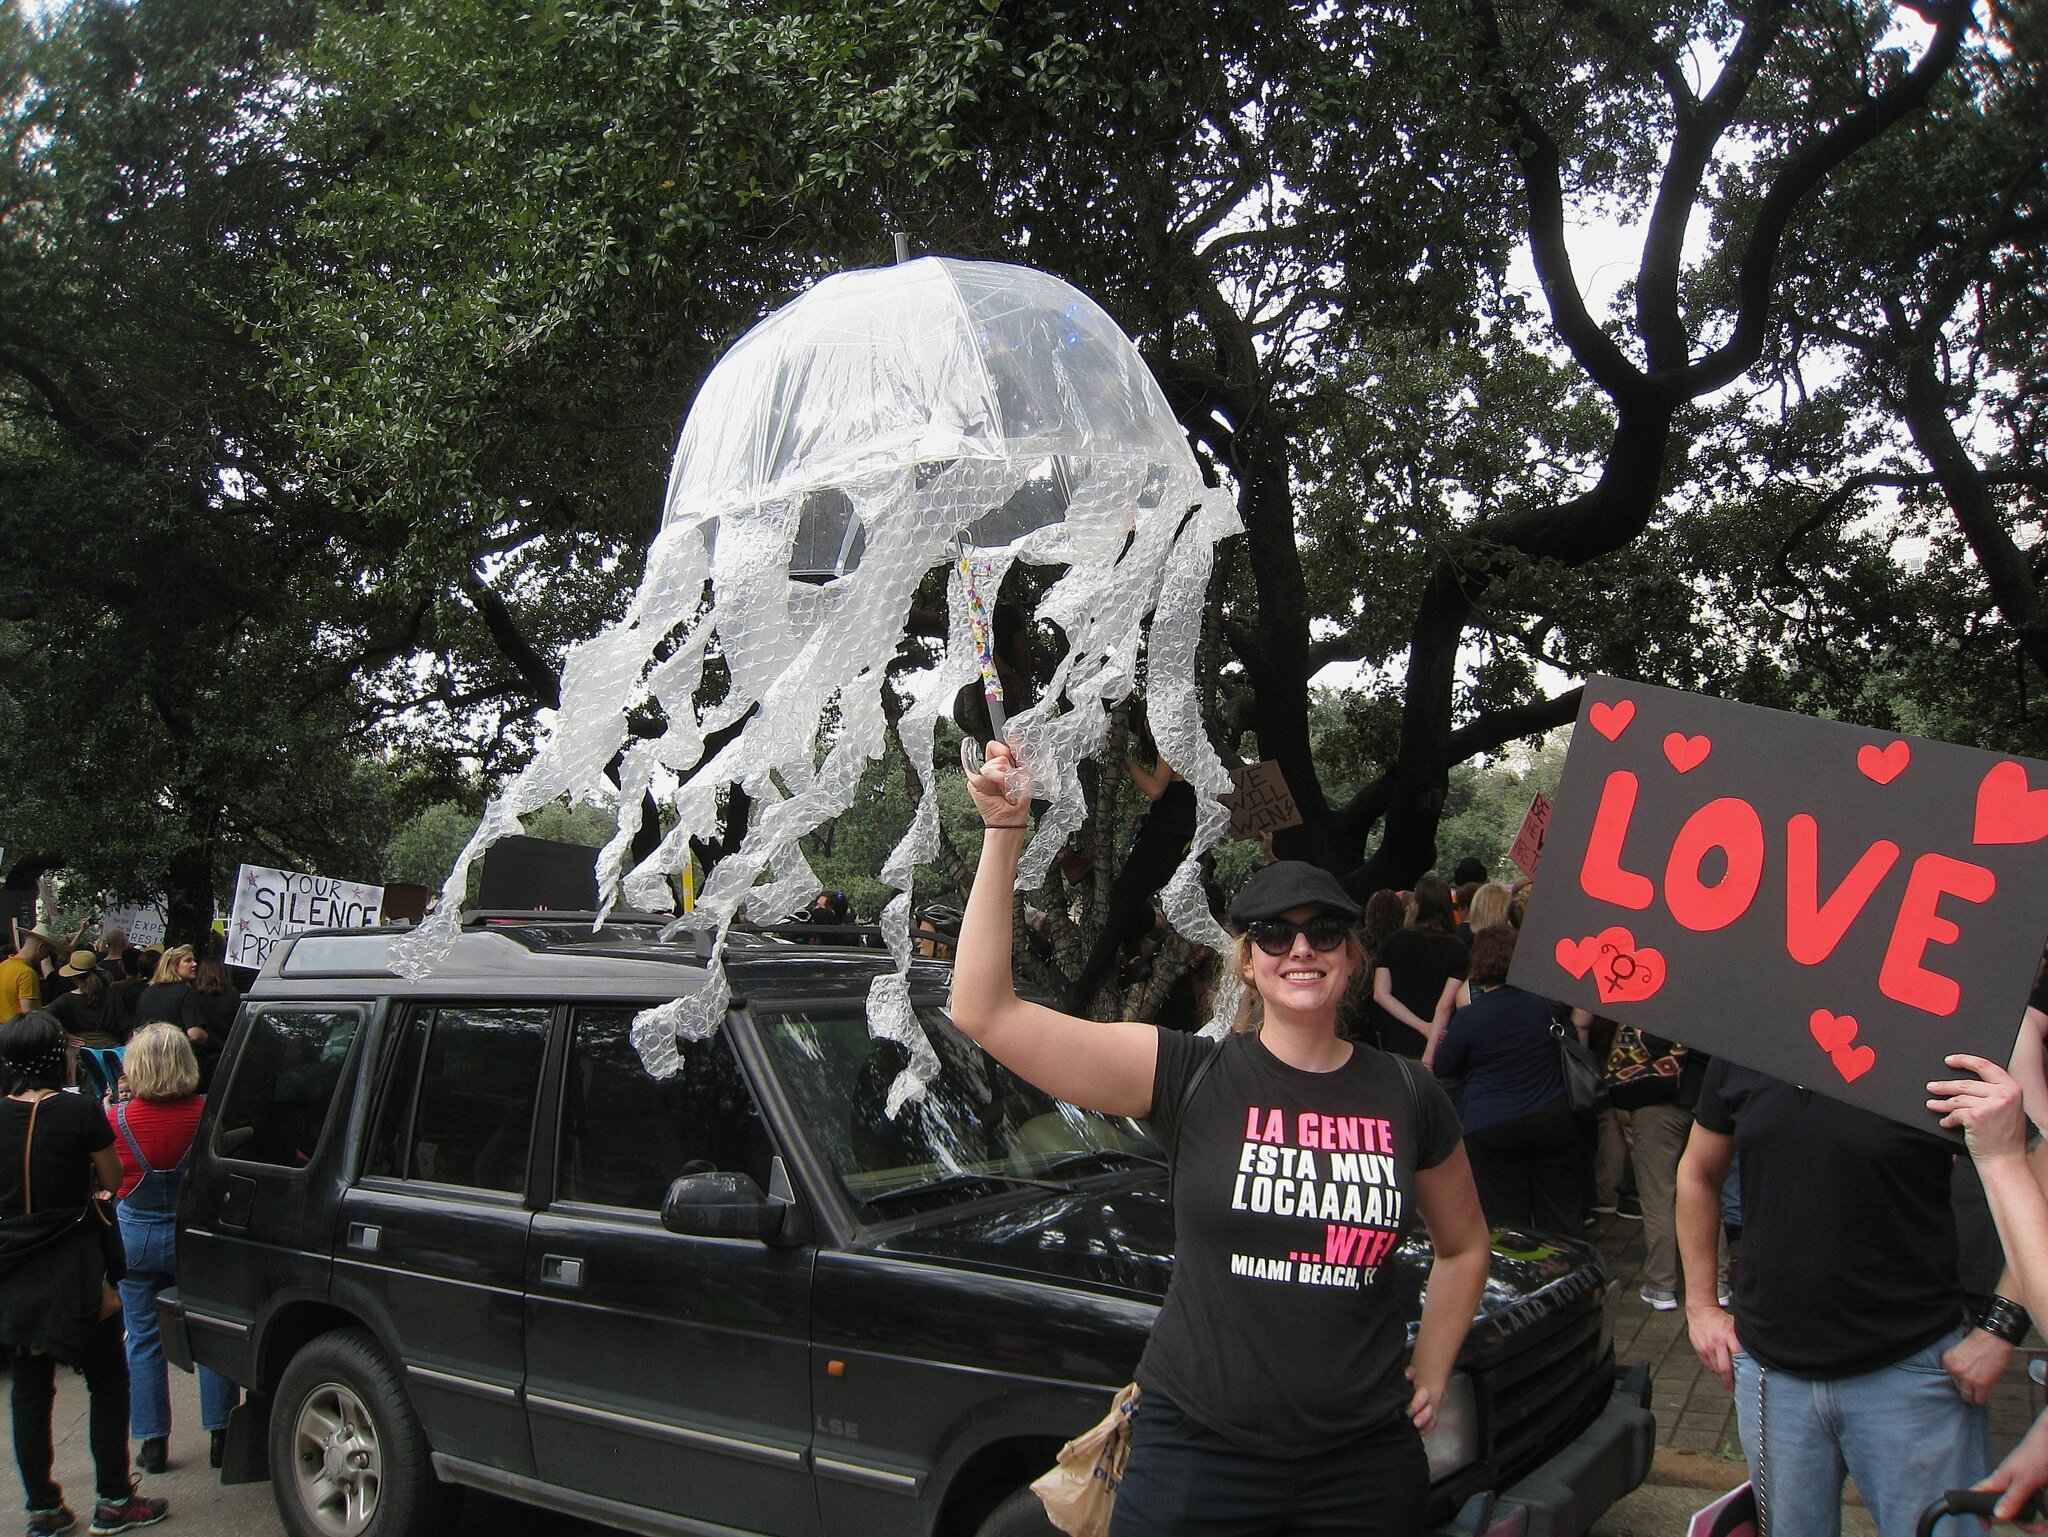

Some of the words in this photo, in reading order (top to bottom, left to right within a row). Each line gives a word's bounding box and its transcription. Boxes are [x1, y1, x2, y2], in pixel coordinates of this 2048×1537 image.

[1232, 799, 1294, 835] WIN!
[1531, 793, 1550, 825] BE
[279, 870, 342, 900] YOUR
[1580, 769, 1997, 1017] LOVE
[251, 887, 378, 928] SILENCE
[263, 920, 304, 936] WI
[1245, 1106, 1284, 1144] LA
[1297, 1112, 1394, 1154] GENTE
[1238, 1141, 1318, 1180] ESTA
[1330, 1152, 1396, 1187] MUY
[1231, 1173, 1402, 1227] LOCAAAA!!
[1289, 1223, 1397, 1266] ...WTF!
[1230, 1253, 1292, 1282] MIAMI
[1298, 1262, 1360, 1290] BEACH,
[1491, 1298, 1548, 1336] LAND
[1549, 1267, 1597, 1307] ROVER
[815, 1415, 860, 1440] LSE
